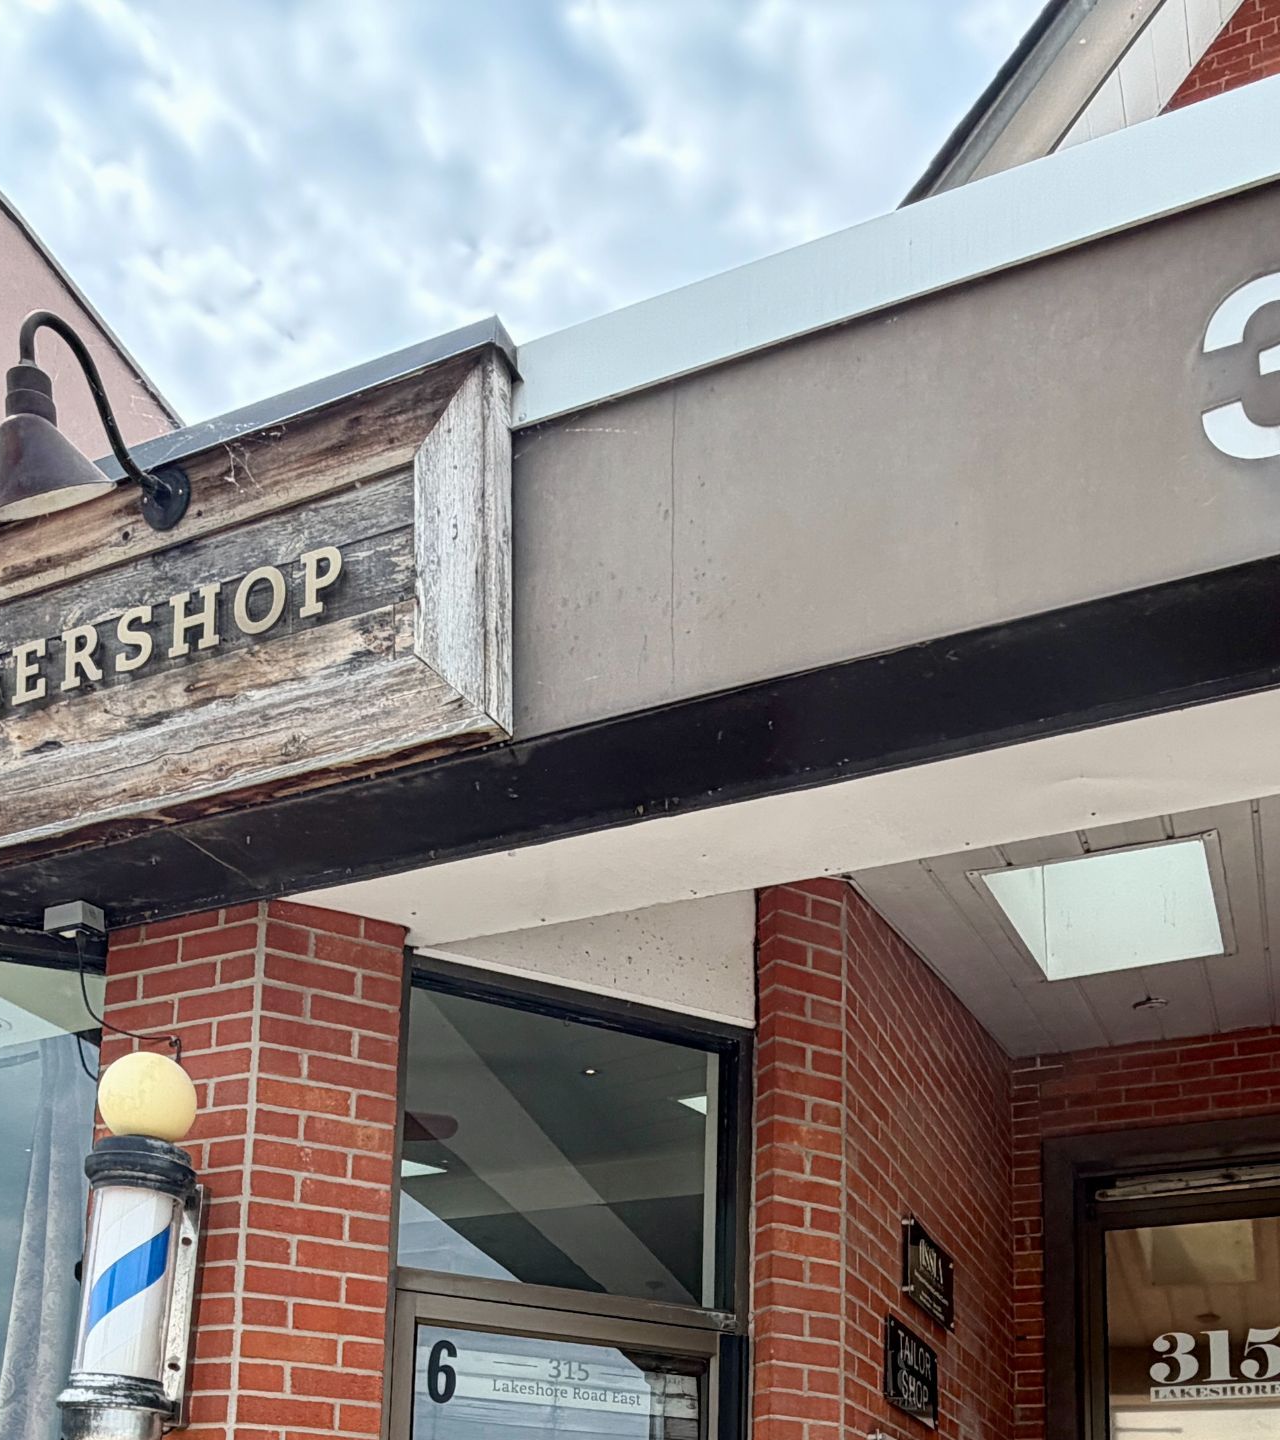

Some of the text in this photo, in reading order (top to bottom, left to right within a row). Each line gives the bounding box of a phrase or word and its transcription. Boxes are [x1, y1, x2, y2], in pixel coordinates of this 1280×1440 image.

[427, 1340, 458, 1404] 6
[548, 1357, 590, 1382] 315
[897, 1328, 933, 1382] TAILOR
[492, 1379, 642, 1407] Lakeshore Road East
[900, 1369, 930, 1411] SHOP
